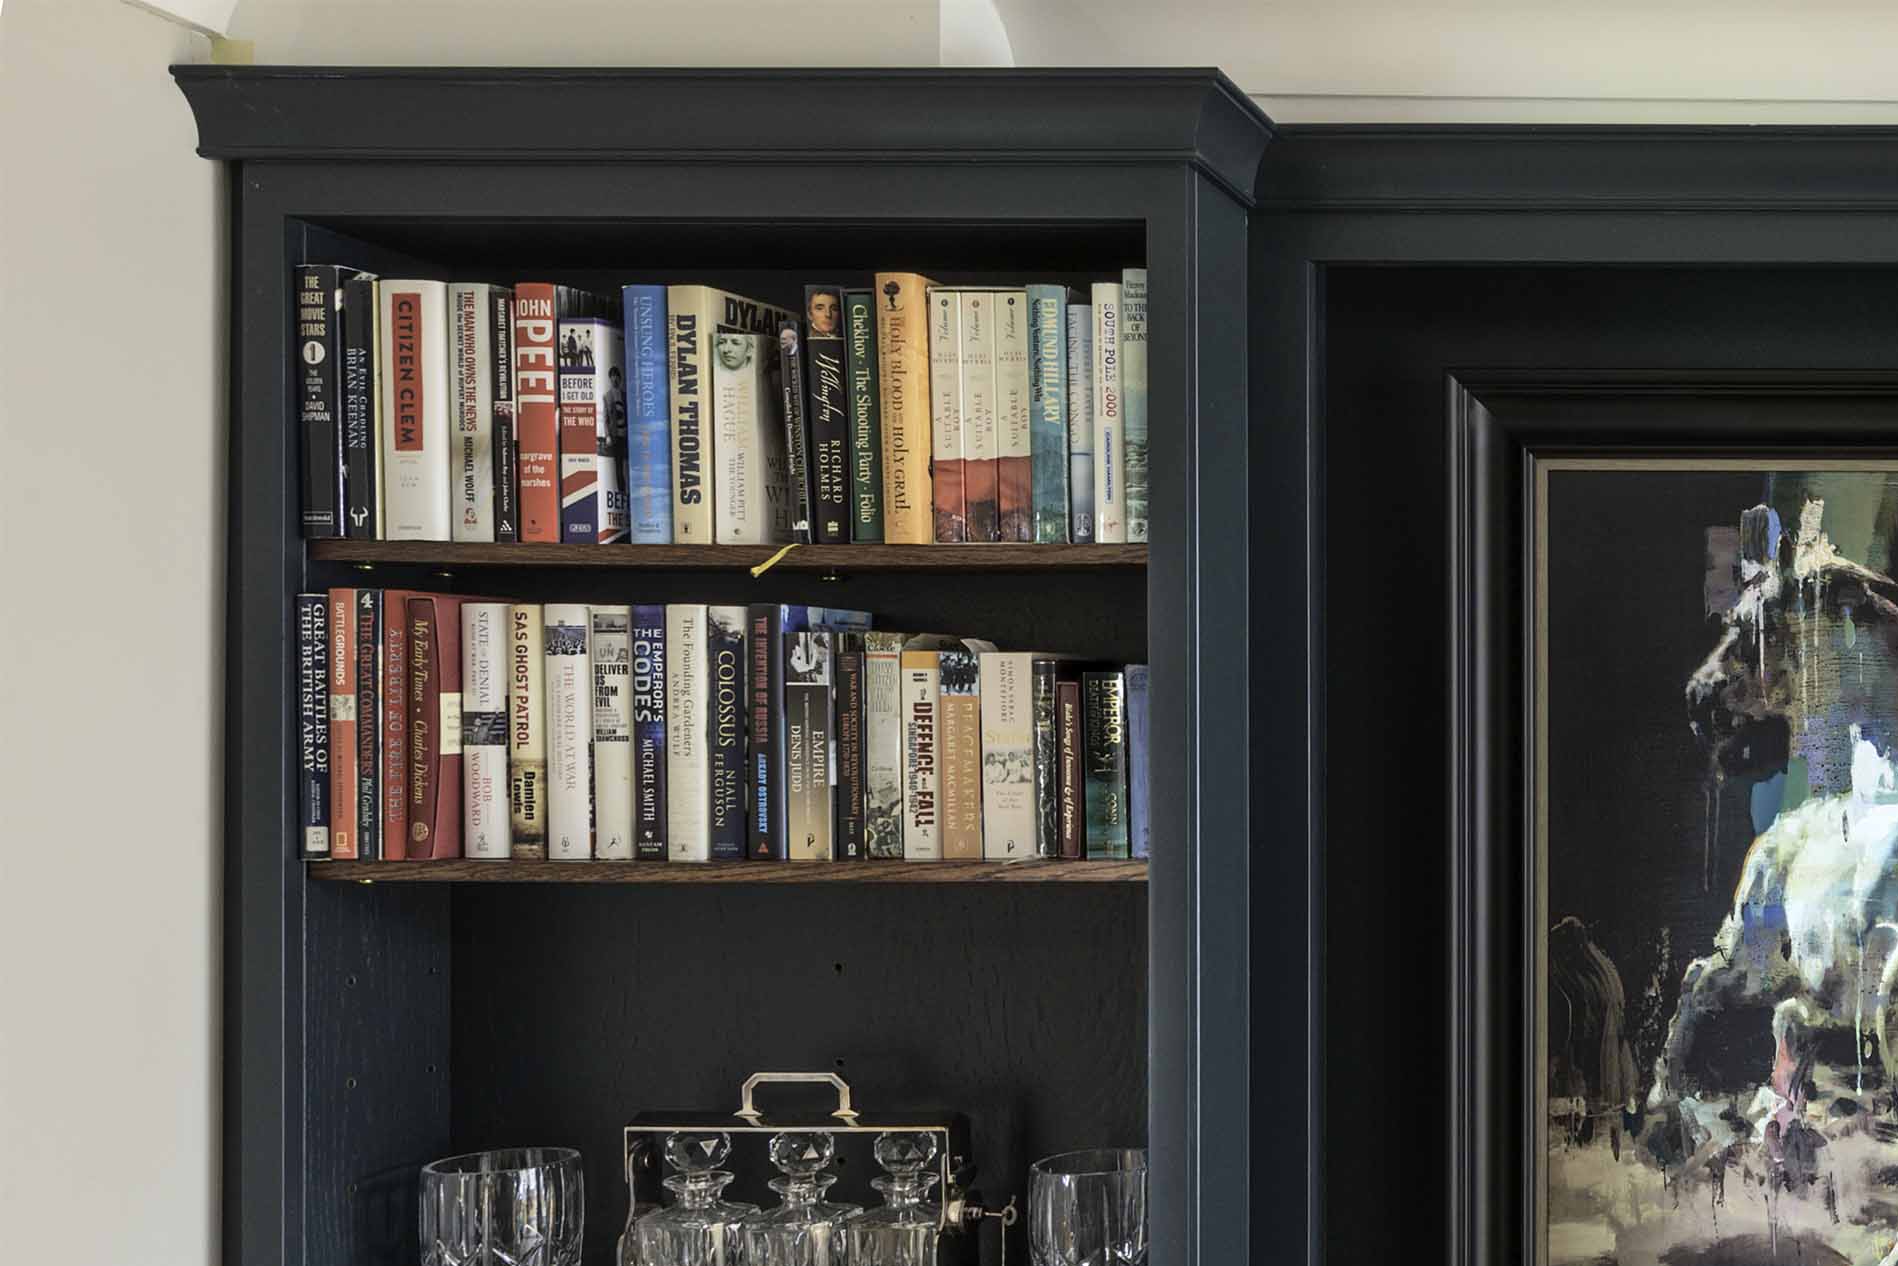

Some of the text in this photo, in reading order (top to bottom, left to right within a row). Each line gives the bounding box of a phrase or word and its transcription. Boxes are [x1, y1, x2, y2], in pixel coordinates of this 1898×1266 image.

[517, 300, 552, 317] JOHN
[348, 349, 360, 449] BRIAN KEENAN
[398, 301, 417, 443] CITIZEN CLEM
[464, 292, 478, 432] THE MAN WHO OWNS THE NEWS
[517, 319, 554, 414] PEEL
[677, 314, 702, 505] DYLAN THOMAS
[853, 304, 876, 524] Chekhov The Shooting Party Folio
[463, 437, 475, 503] MICHAEL WOLFF
[819, 443, 831, 501] HOLMES
[831, 440, 843, 505] RICHARD
[313, 603, 327, 663] GREAT
[633, 628, 662, 639] THE
[301, 603, 315, 773] THE BRITISH ARMY
[314, 669, 328, 745] BATTLES
[413, 619, 429, 805] My Early Times Charles Dickens
[515, 611, 530, 751] SAS GHOST PATROL
[634, 640, 651, 722] CODES
[652, 641, 664, 722] EMPEROR'S
[717, 650, 738, 747] COLOSSUS
[315, 750, 329, 773] OF
[512, 778, 525, 815] Lewis
[524, 771, 537, 821] Damien
[643, 738, 656, 822] MICHAEL SMITH
[790, 725, 803, 792] DENIS JUDD
[812, 730, 825, 788] EMPIRE
